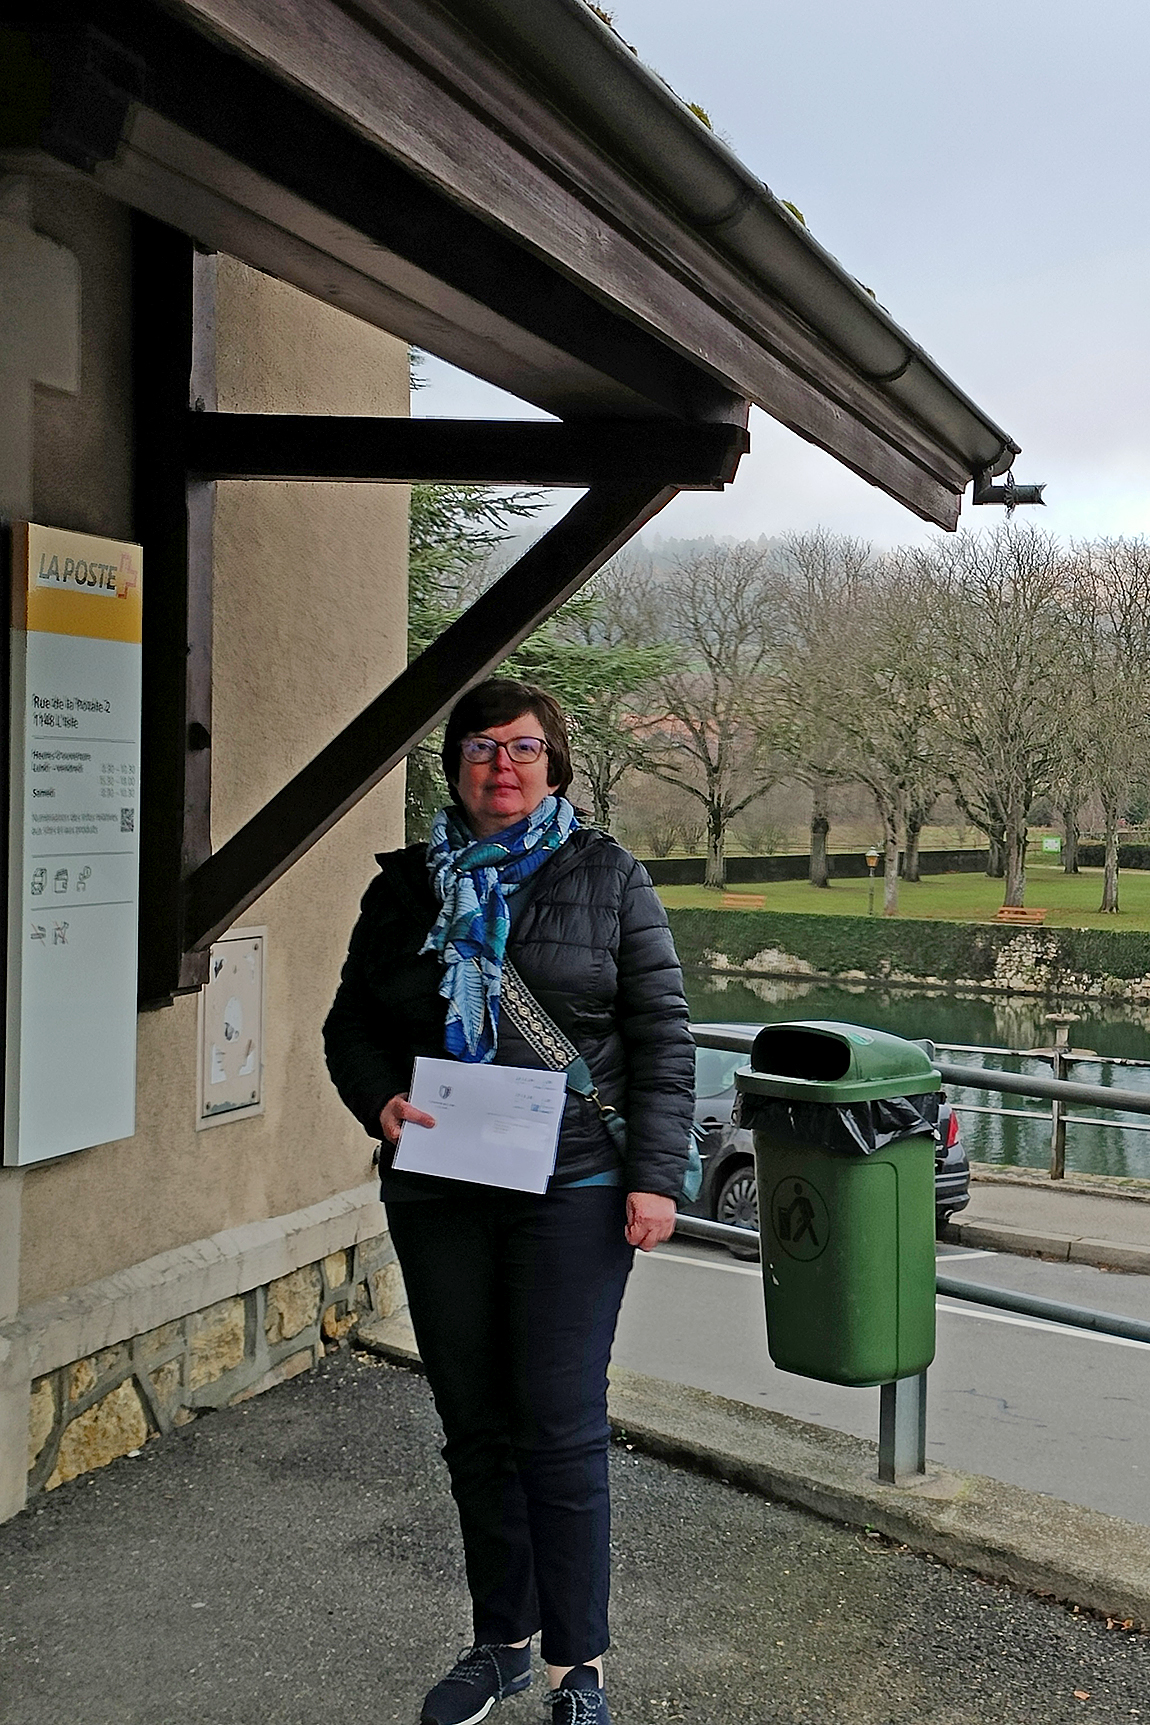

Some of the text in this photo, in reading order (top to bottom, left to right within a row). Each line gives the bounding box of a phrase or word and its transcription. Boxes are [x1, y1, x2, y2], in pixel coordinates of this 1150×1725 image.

[39, 553, 118, 590] LA POSTE
[33, 695, 50, 709] Rue
[53, 698, 64, 710] de
[67, 699, 74, 711] la
[104, 700, 111, 713] 2
[33, 714, 55, 728] 1148
